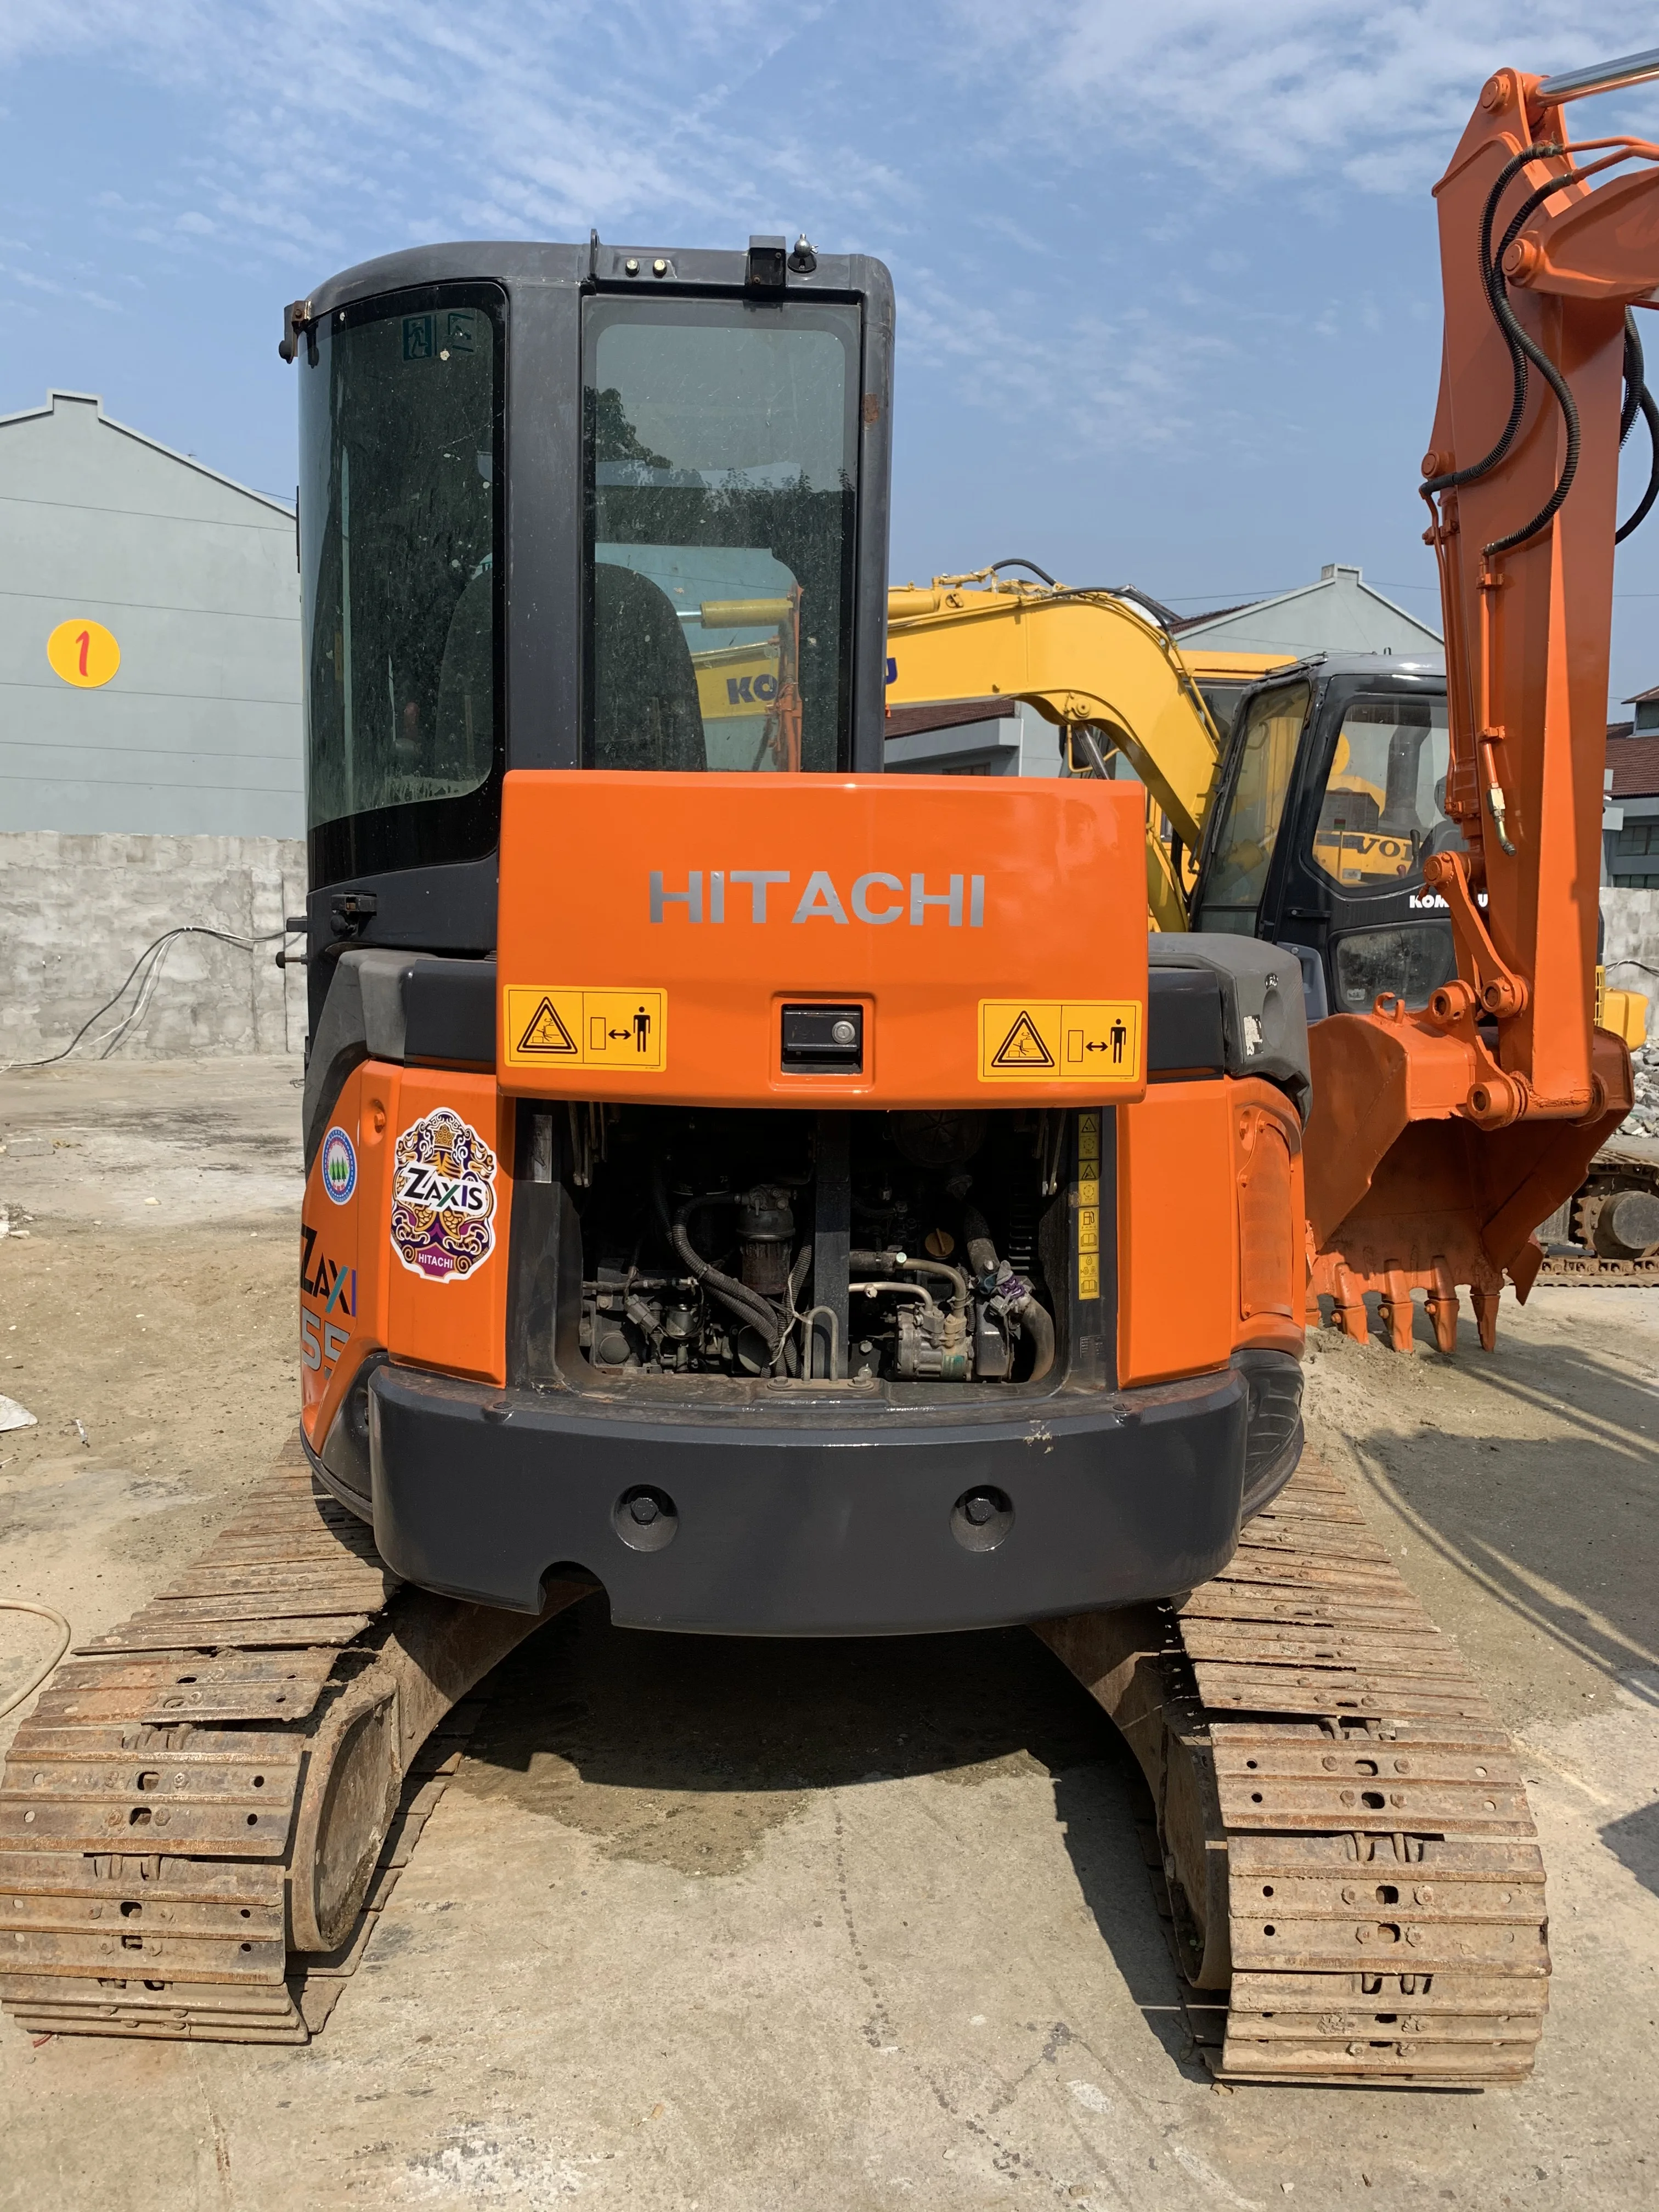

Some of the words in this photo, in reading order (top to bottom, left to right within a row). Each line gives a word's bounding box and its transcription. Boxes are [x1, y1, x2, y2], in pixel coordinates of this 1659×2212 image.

[75, 629, 90, 677] 1
[649, 870, 985, 927] HITACHI
[1409, 894, 1488, 908] KOMU
[404, 1167, 483, 1211] ZAXIS
[418, 1252, 453, 1269] HITACHI
